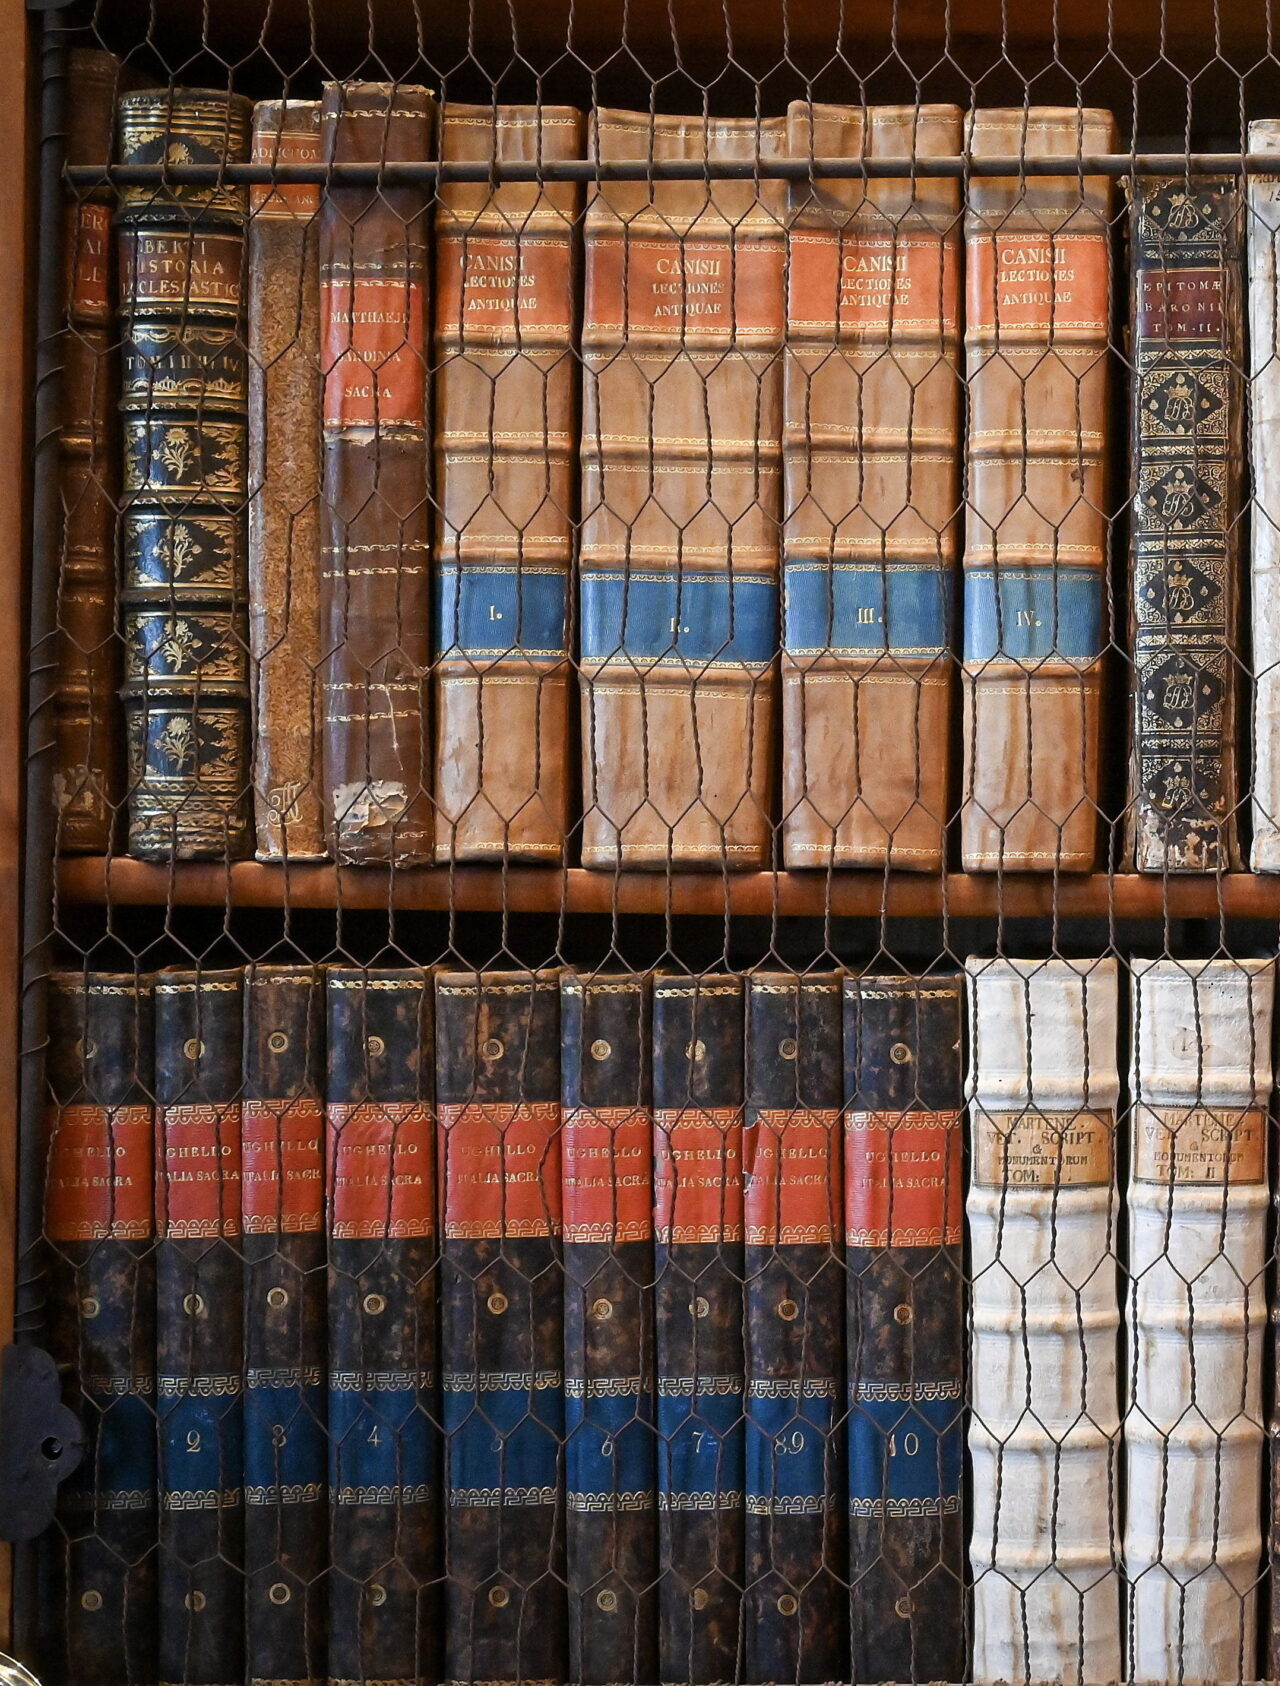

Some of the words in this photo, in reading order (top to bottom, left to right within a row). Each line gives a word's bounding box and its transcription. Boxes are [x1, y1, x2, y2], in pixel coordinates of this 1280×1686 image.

[460, 254, 525, 271] CANISI
[843, 256, 907, 272] CANISII
[1001, 248, 1066, 265] CANISII
[656, 258, 721, 275] CANISII
[840, 294, 909, 308] ANTIQUAE
[1002, 291, 1072, 306] ANTIQUAE
[655, 303, 722, 317] ANTQUAE
[157, 1145, 232, 1159] GHELLO
[242, 1139, 320, 1154] UGHLLO
[186, 1429, 201, 1453] 2
[366, 1425, 382, 1448] 4
[691, 1431, 707, 1455] 7
